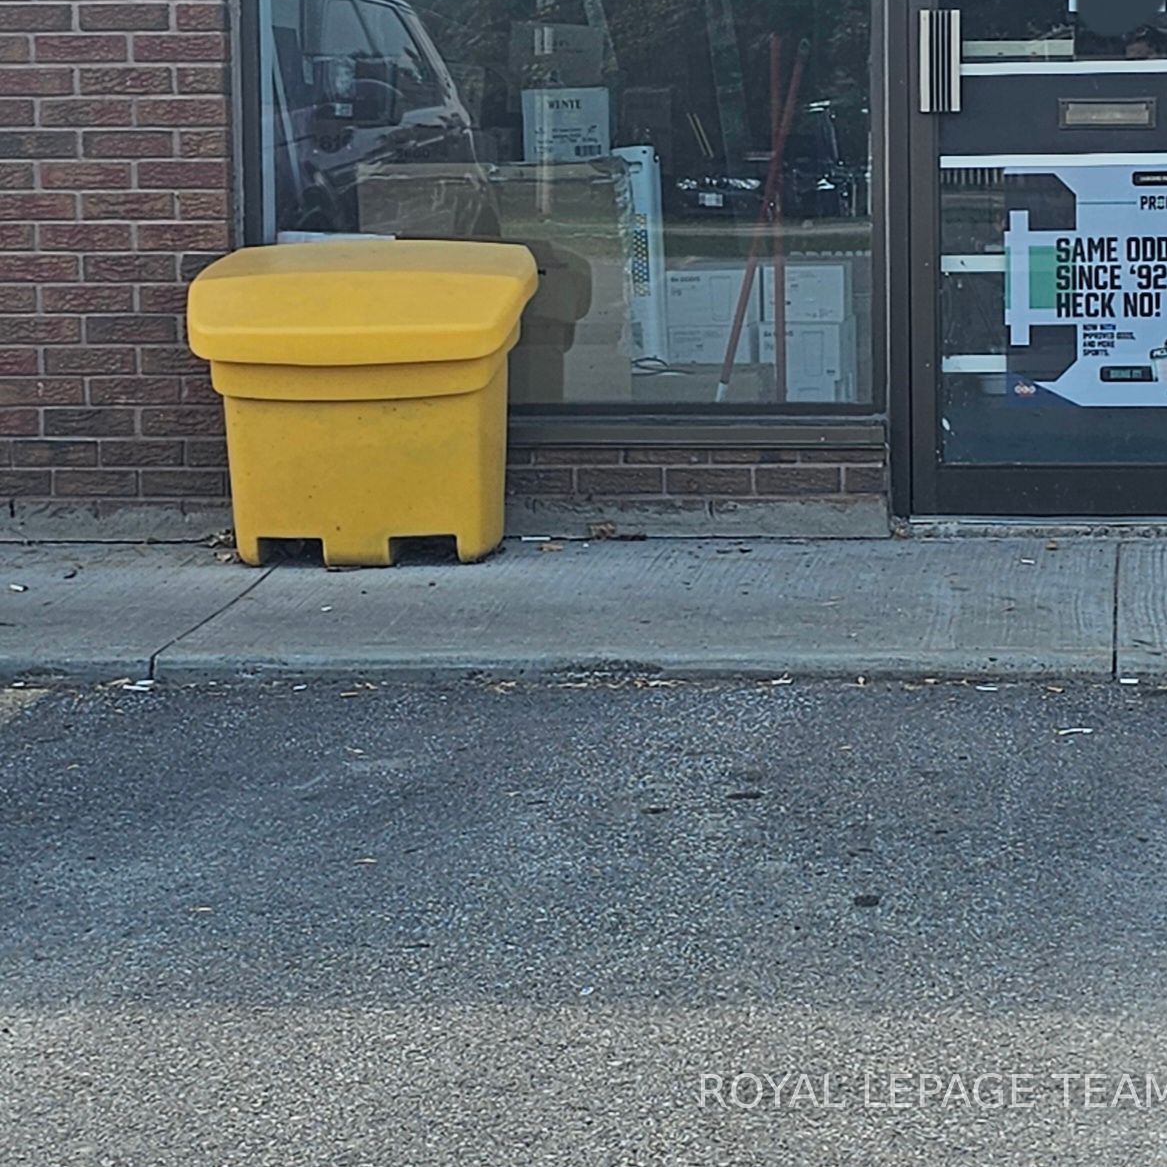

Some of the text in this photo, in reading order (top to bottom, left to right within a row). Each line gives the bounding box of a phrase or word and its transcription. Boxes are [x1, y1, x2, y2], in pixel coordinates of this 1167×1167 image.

[1056, 237, 1119, 263] SAME
[1056, 265, 1122, 290] SINCE
[1056, 292, 1161, 318] HECK NO!
